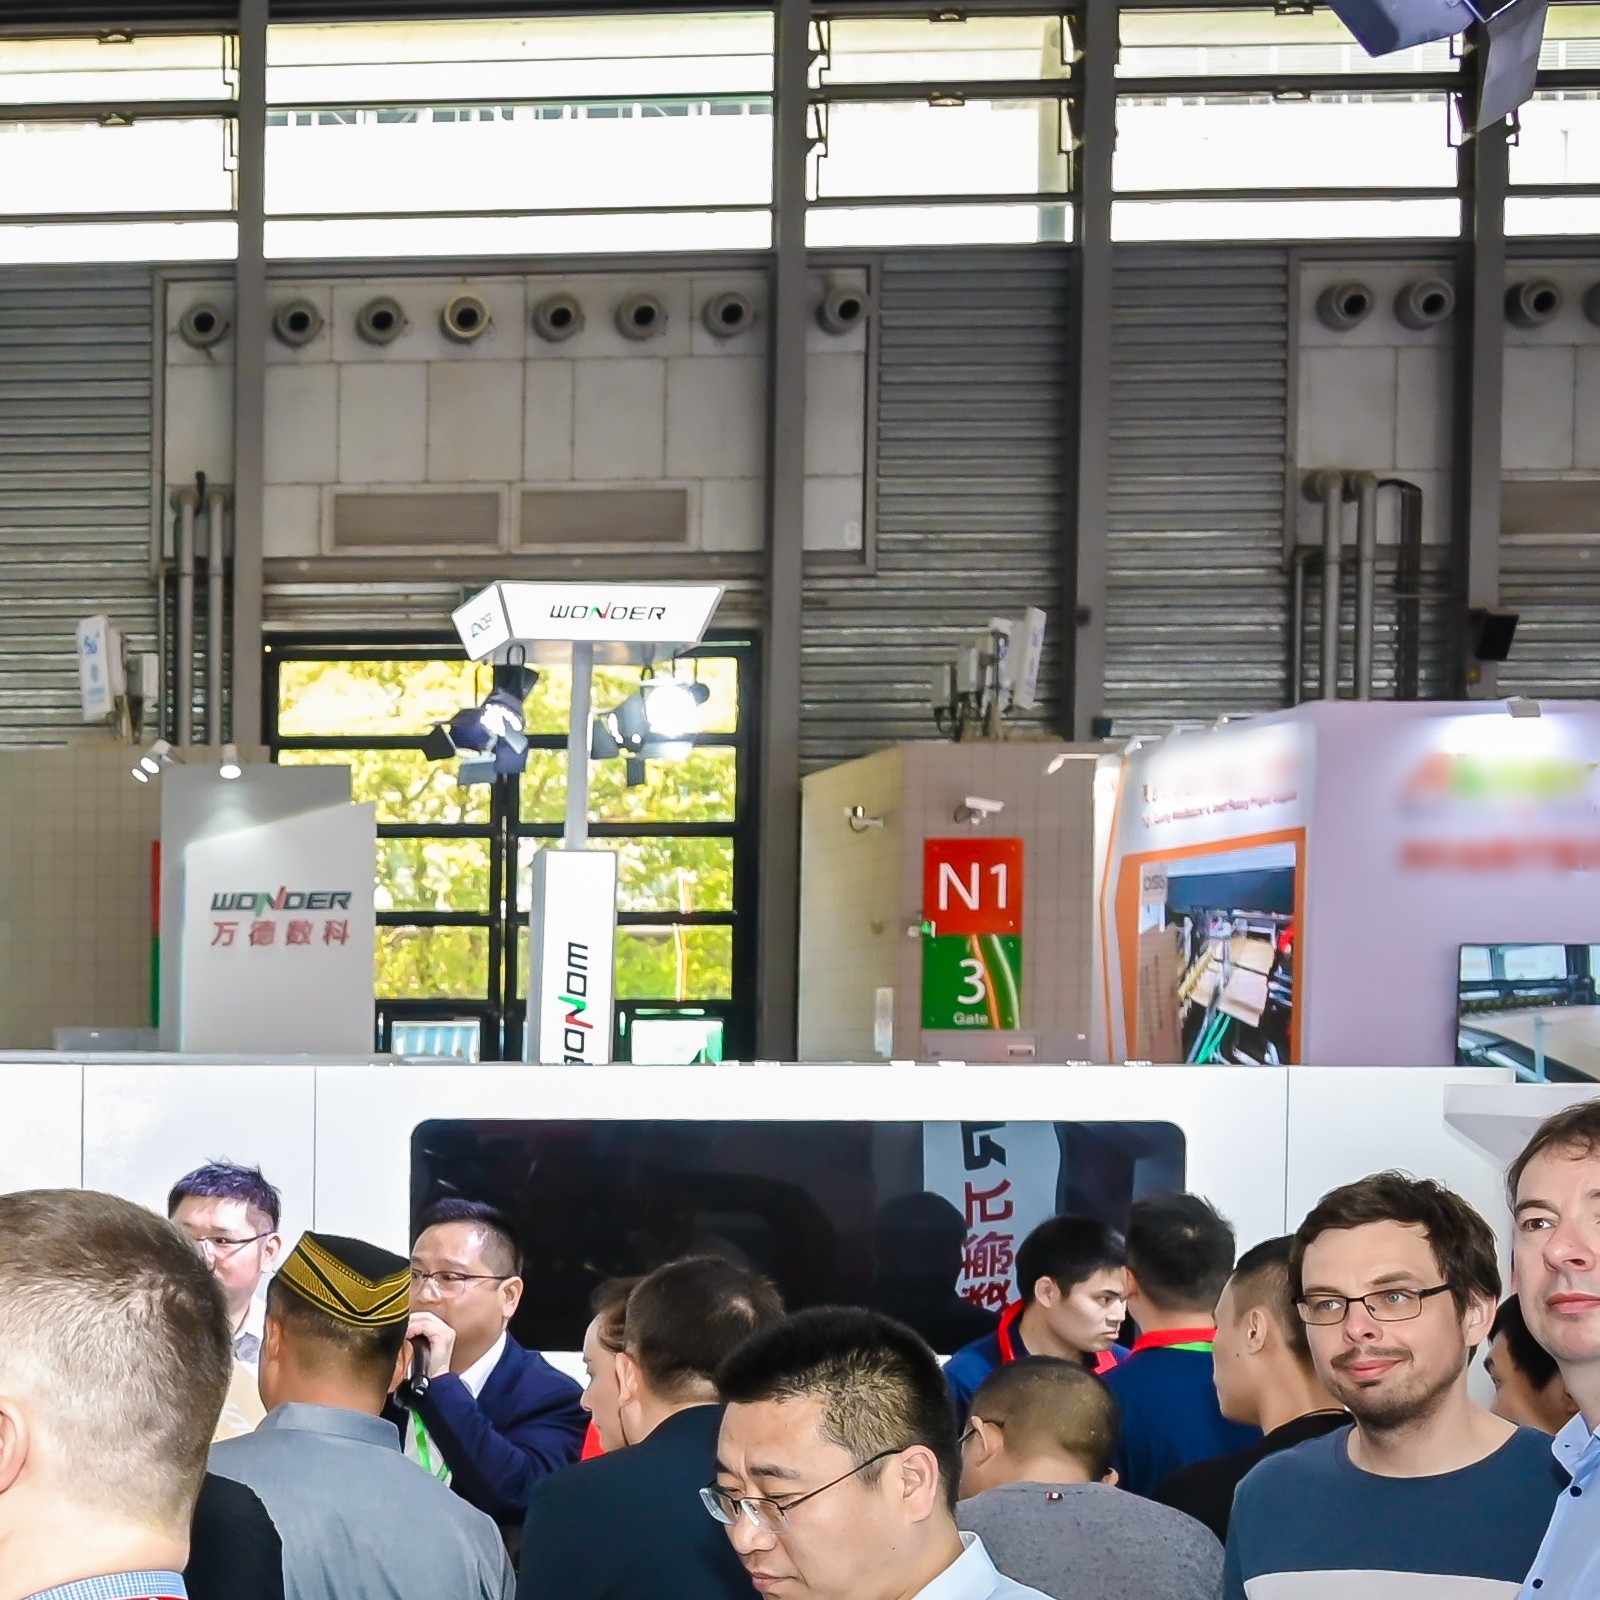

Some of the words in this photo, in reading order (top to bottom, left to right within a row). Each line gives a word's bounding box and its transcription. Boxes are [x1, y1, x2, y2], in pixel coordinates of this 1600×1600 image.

[550, 602, 666, 620] WONDER
[938, 862, 1008, 911] N1
[211, 886, 352, 917] WONDER
[211, 919, 351, 946] 万德数科
[957, 958, 987, 1005] 3
[953, 1011, 989, 1026] Gate
